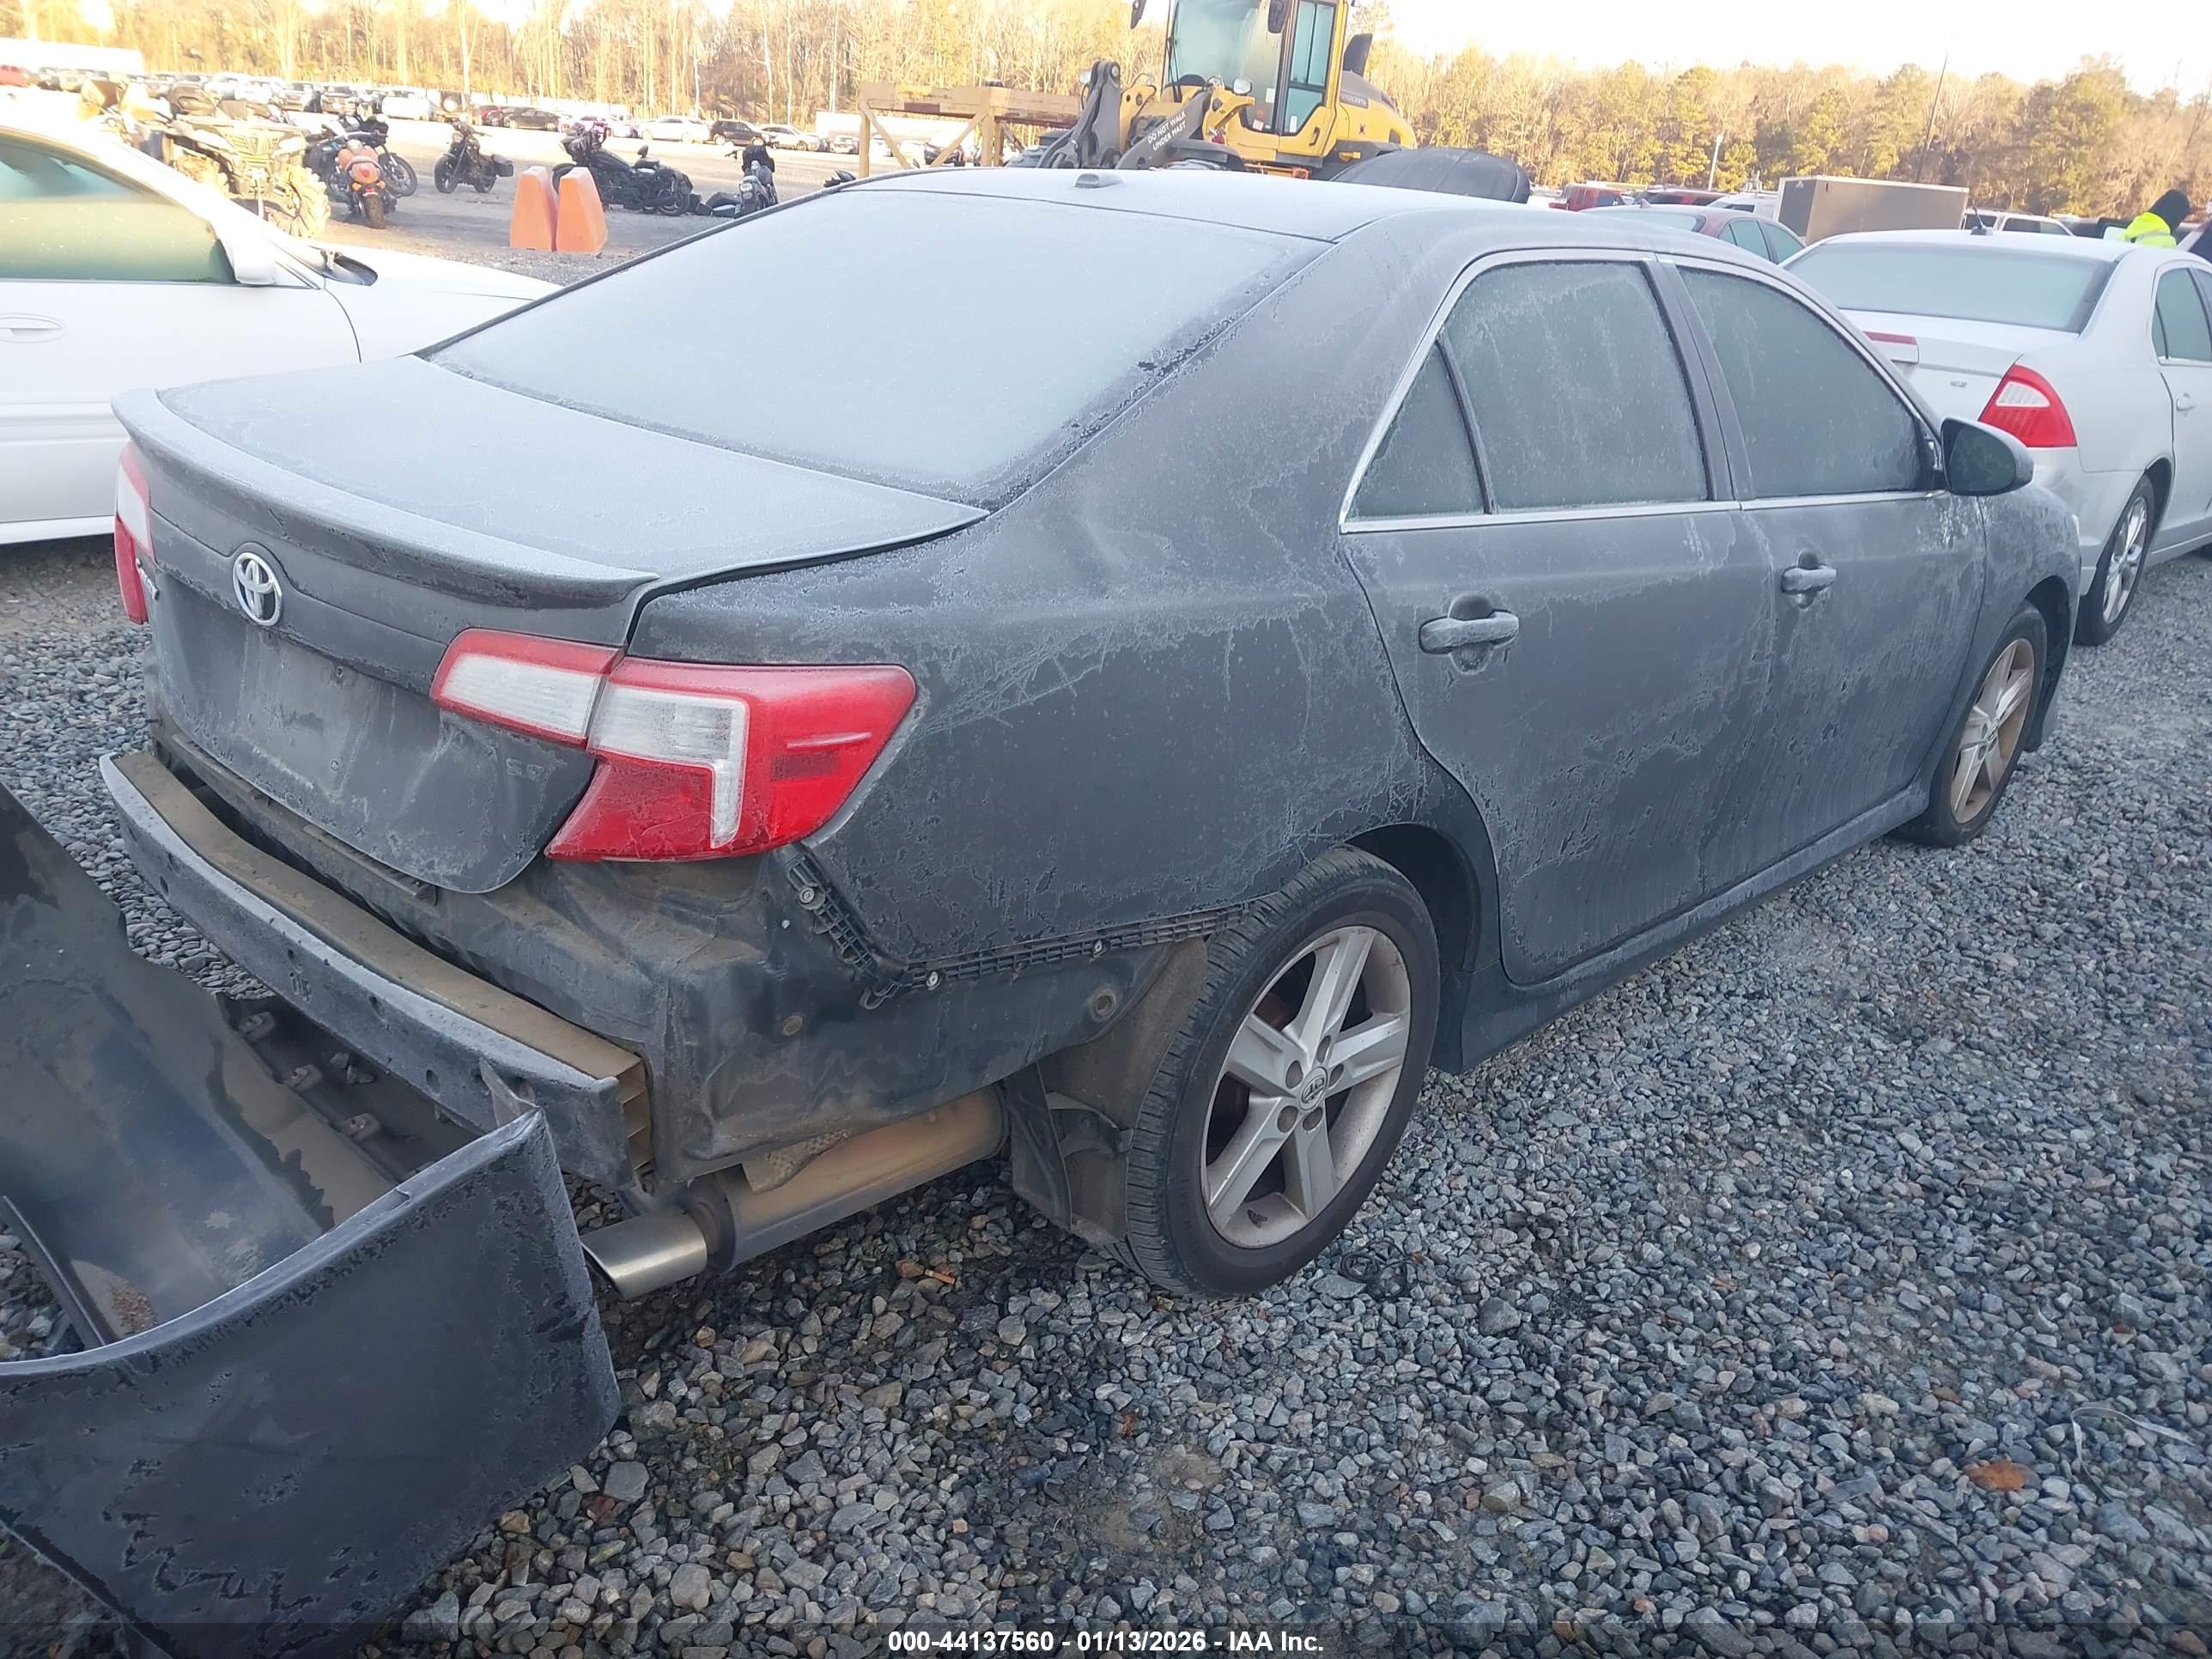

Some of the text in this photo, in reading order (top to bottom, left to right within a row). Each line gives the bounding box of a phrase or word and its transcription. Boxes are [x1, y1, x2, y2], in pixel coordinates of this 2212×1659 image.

[1147, 109, 1187, 143] DO NOT WALK
[1152, 120, 1186, 151] UNDER MAST
